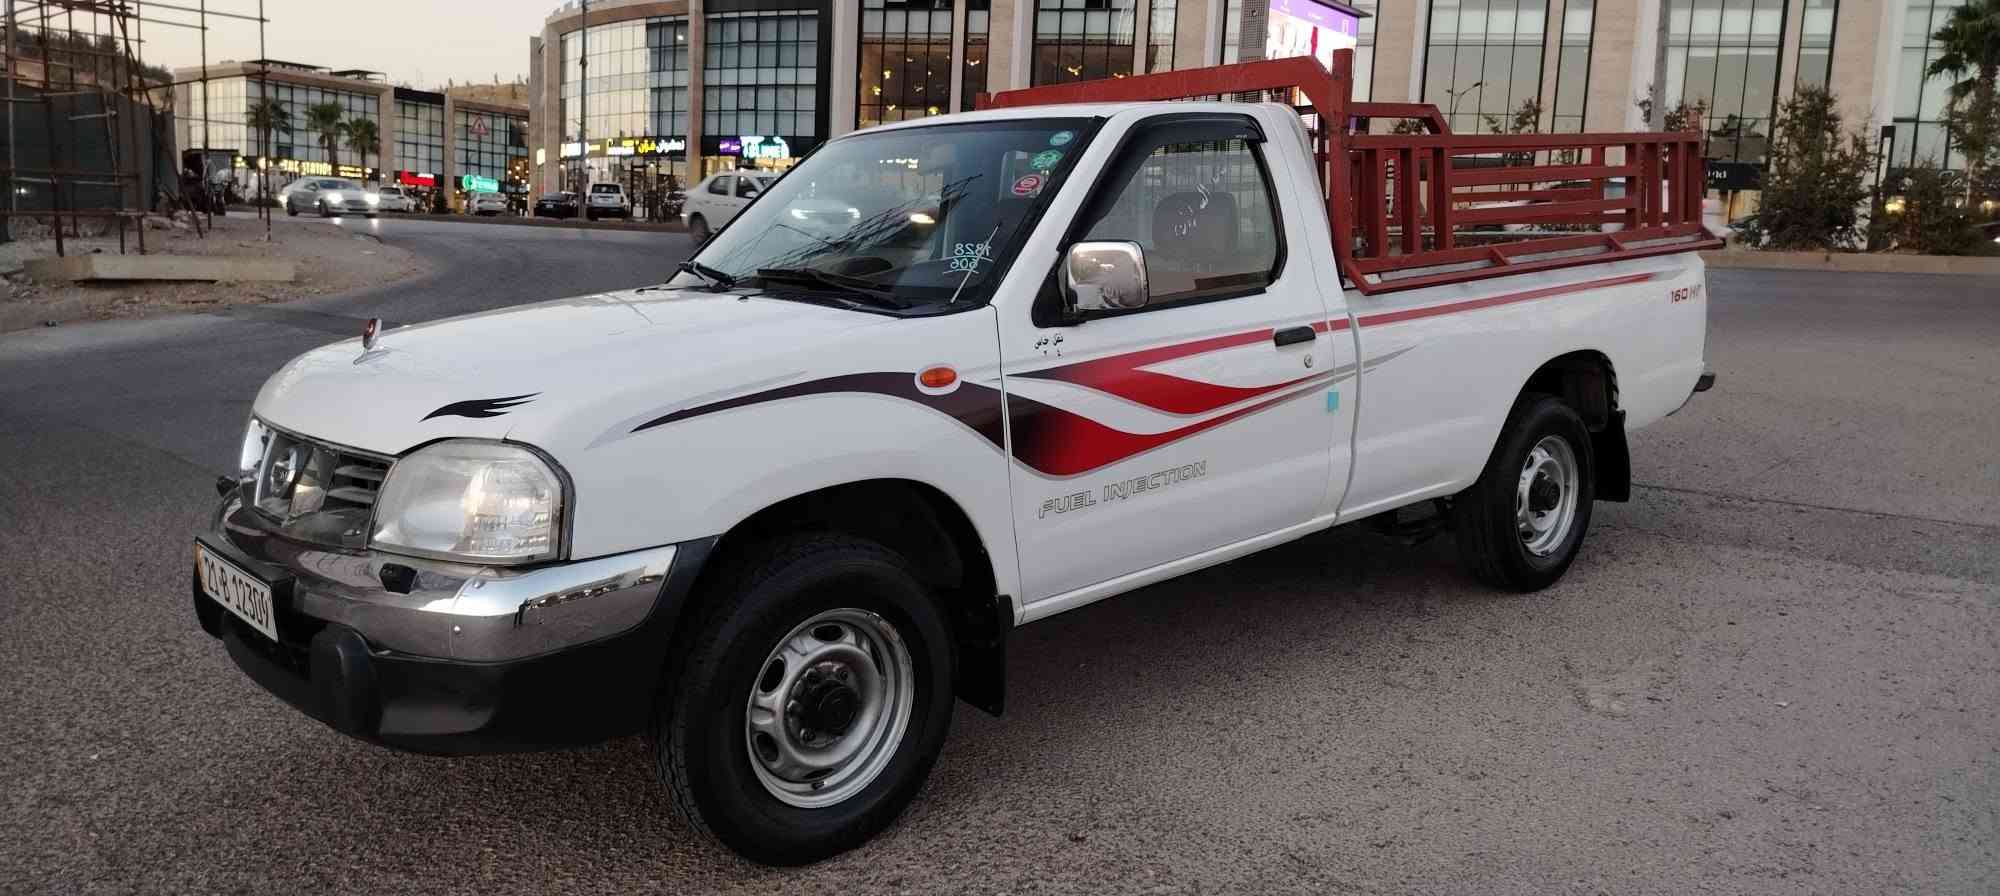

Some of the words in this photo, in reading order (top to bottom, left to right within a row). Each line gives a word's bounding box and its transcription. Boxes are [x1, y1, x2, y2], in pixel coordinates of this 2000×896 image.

[1671, 287, 1688, 304] 160
[1038, 490, 1097, 520] FUEL
[1103, 459, 1207, 502] INJECTION
[232, 574, 269, 629] 12309
